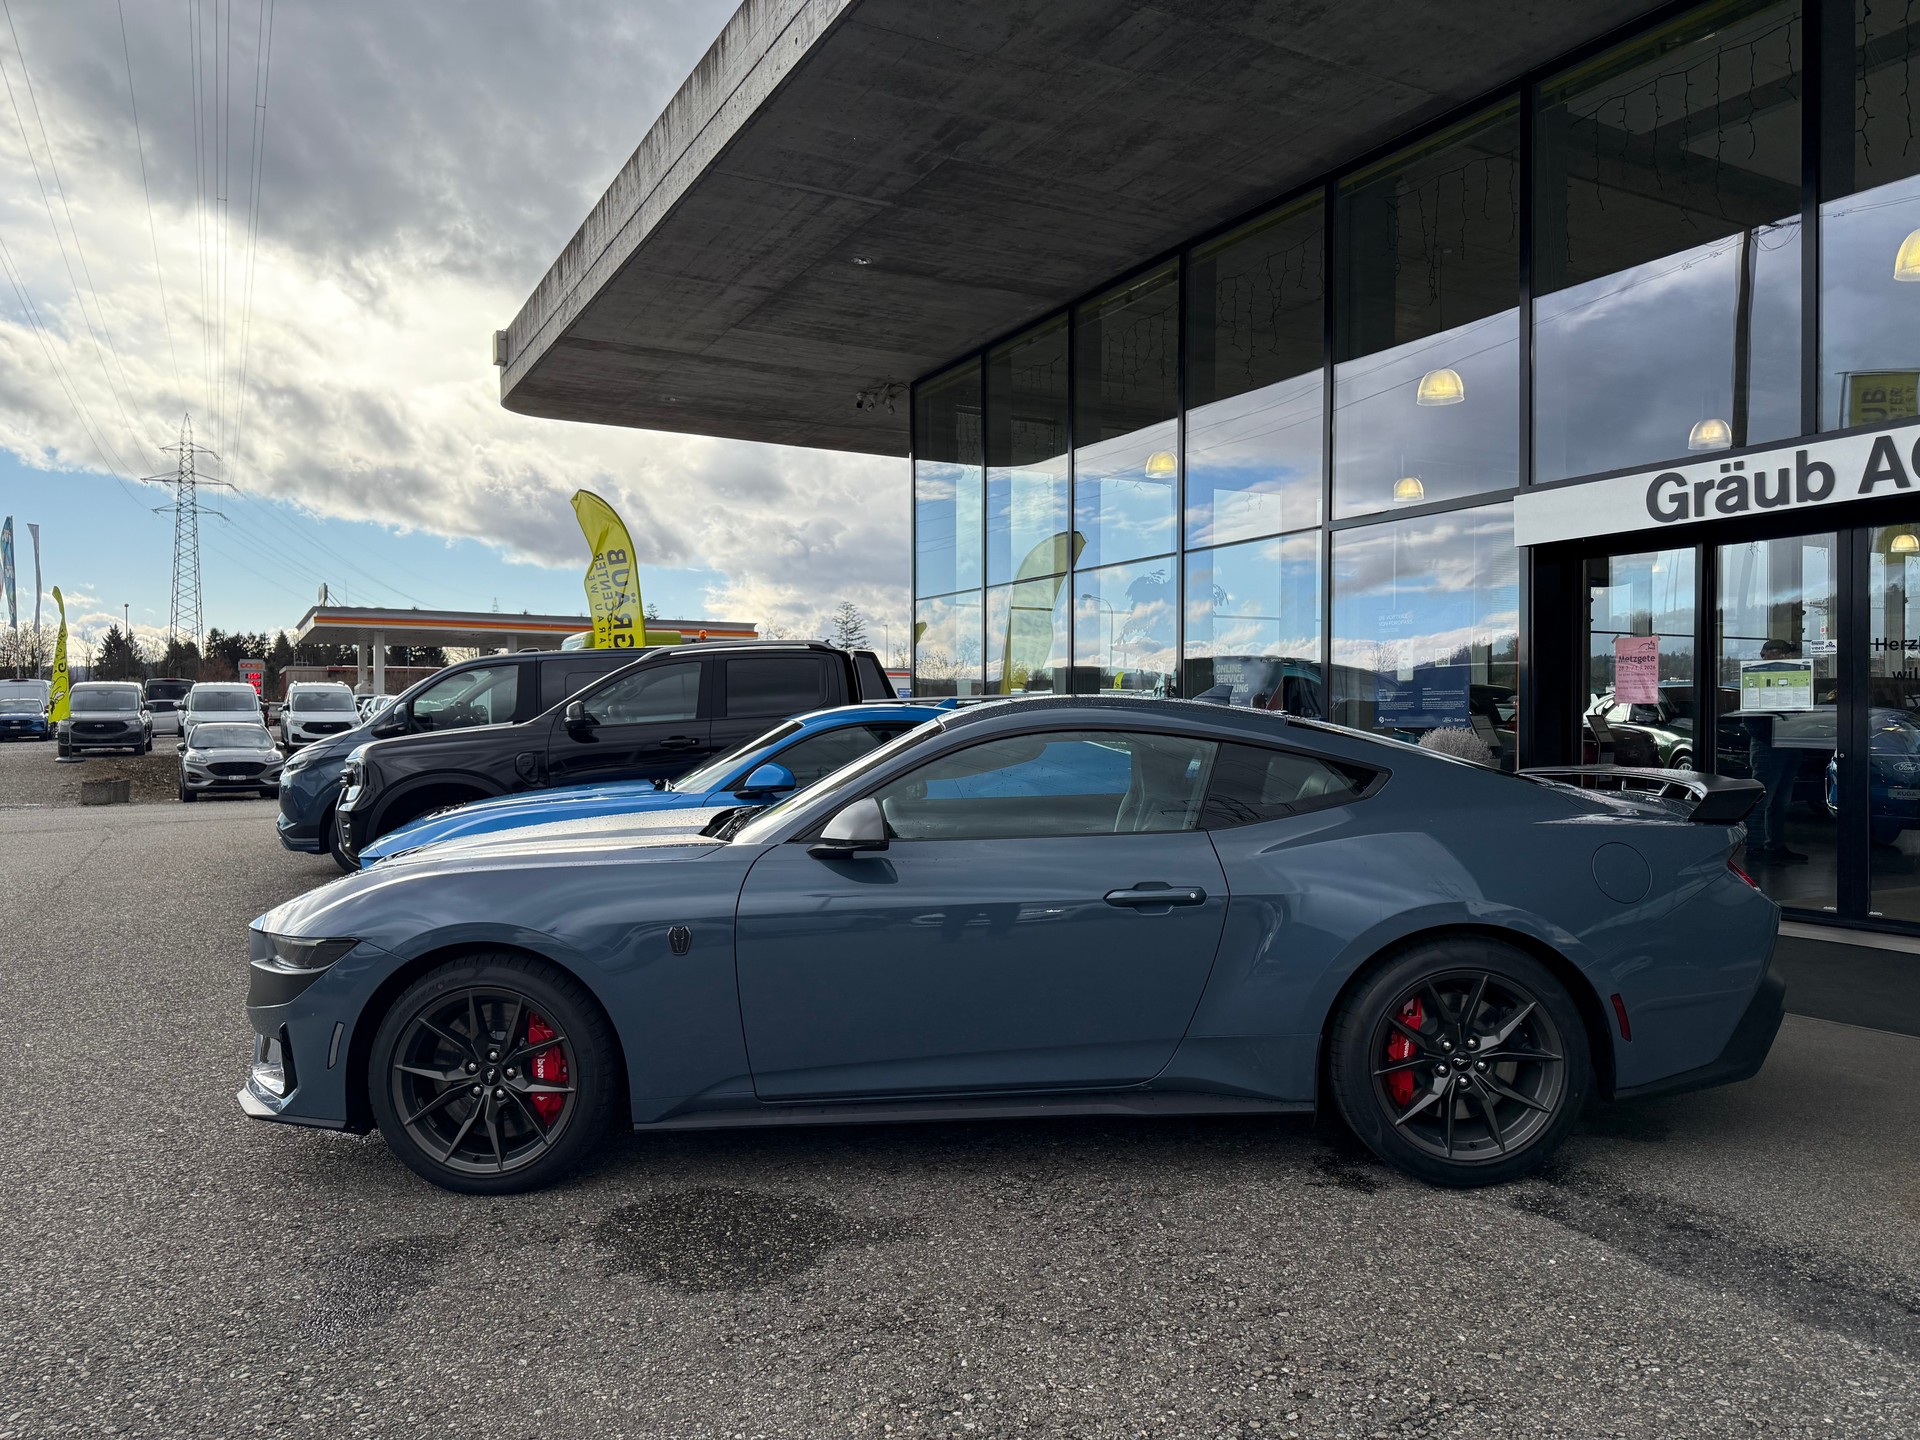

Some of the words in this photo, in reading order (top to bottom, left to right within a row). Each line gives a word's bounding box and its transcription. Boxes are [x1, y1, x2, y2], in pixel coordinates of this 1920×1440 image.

[1646, 450, 1835, 523] Gräub
[1858, 435, 1920, 494] A
[1618, 655, 1656, 664] Metzgete
[1216, 664, 1242, 673] ONLINE
[1216, 674, 1245, 683] SERVICE
